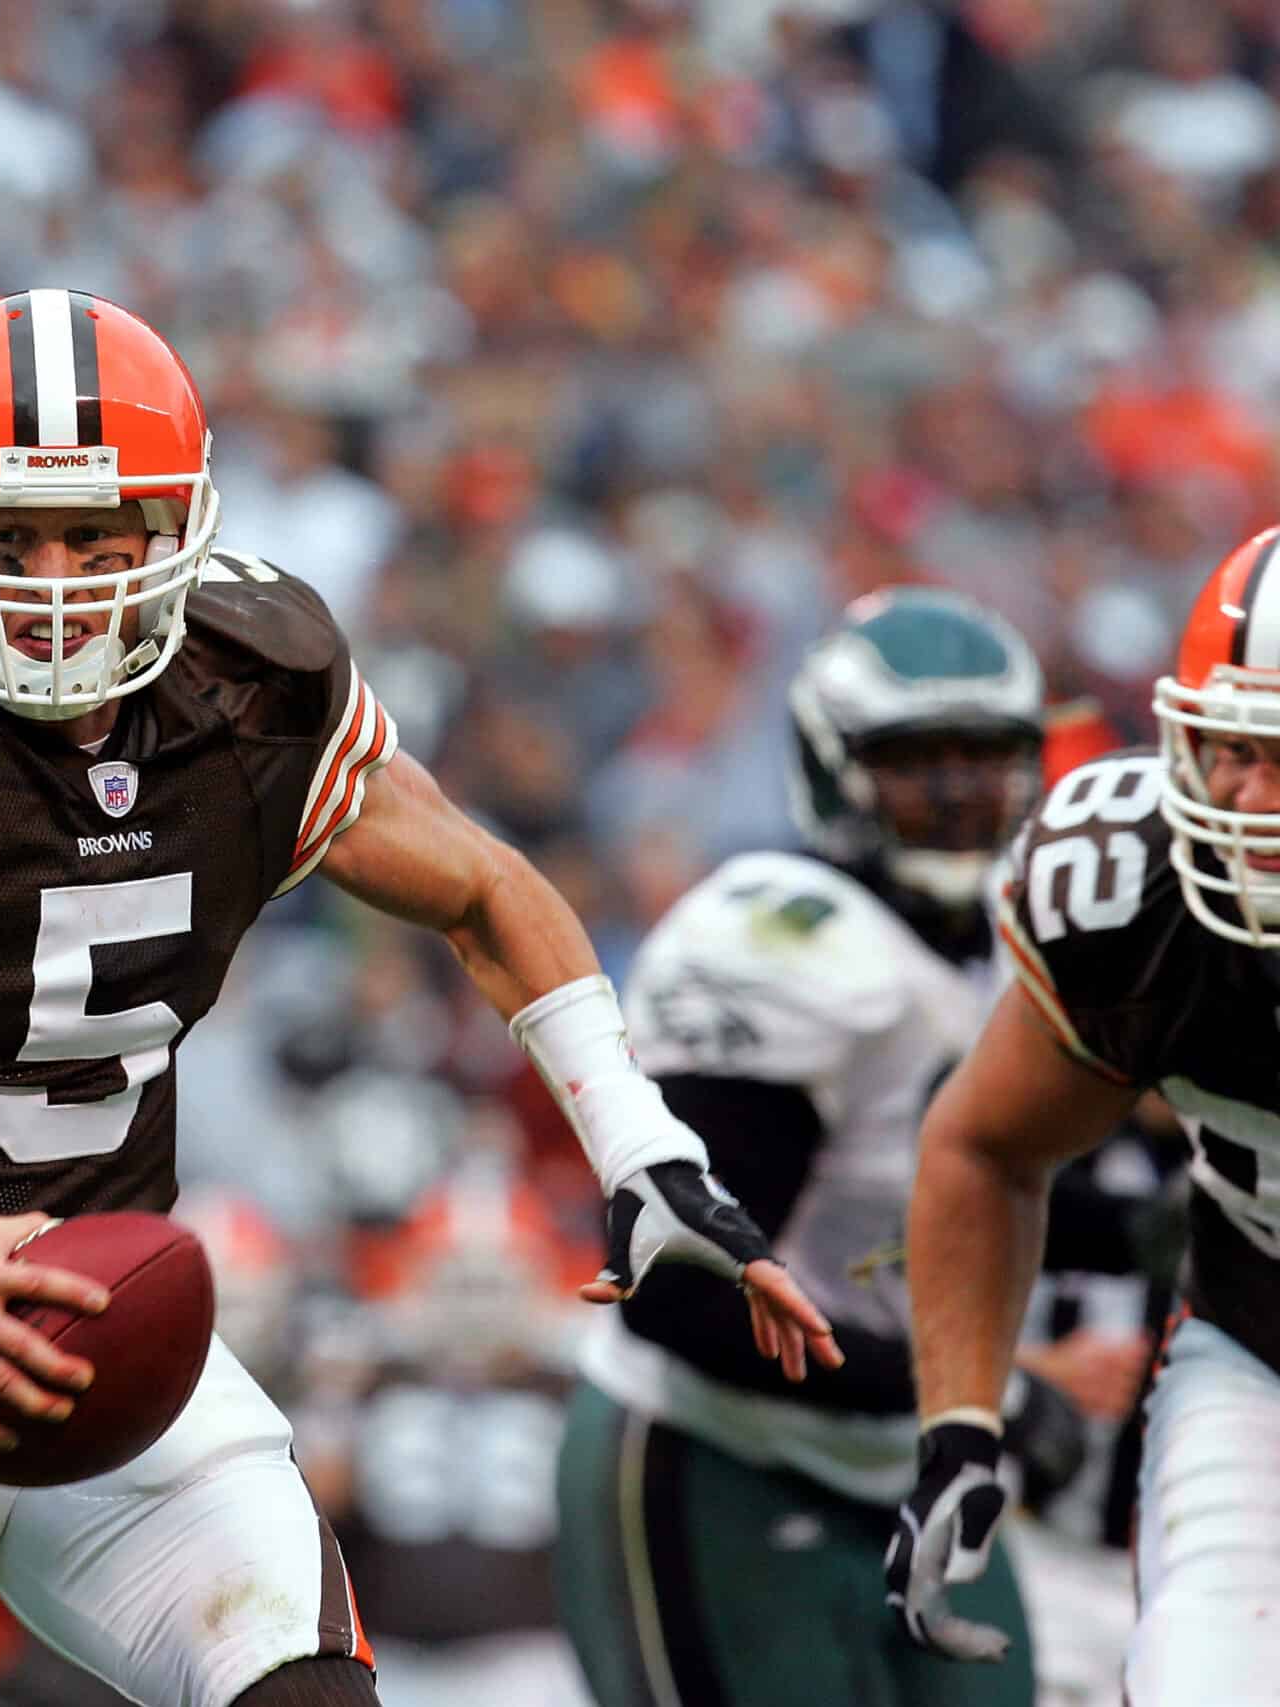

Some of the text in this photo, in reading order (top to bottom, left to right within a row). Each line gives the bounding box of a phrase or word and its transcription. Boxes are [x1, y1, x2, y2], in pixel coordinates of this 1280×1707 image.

[26, 454, 89, 468] BROWNS
[106, 790, 129, 807] NFL
[77, 830, 153, 857] BROWNS
[1026, 755, 1166, 944] 82
